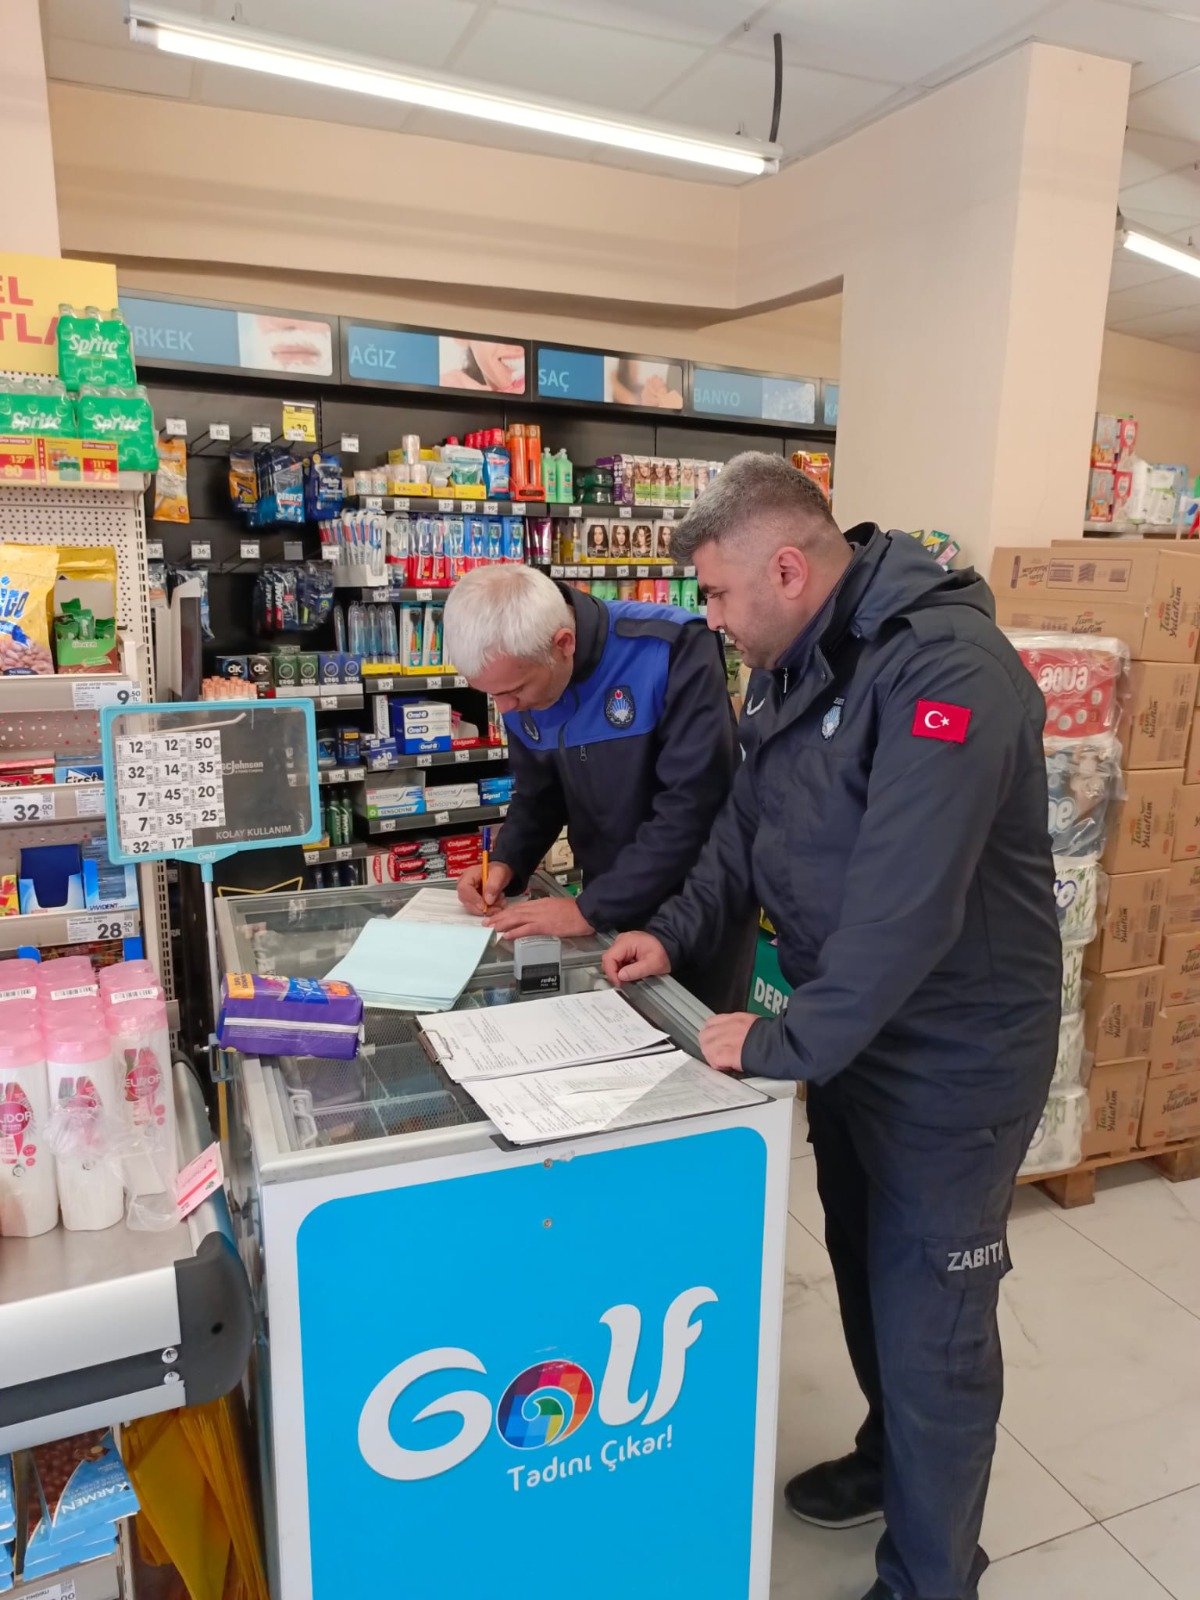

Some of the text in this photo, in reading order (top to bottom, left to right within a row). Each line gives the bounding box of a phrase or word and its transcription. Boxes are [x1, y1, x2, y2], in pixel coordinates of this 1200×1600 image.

[133, 325, 194, 351] RKEK
[69, 334, 119, 355] Sprite
[350, 343, 397, 370] AĞIZ
[538, 368, 570, 392] SAÇ
[694, 387, 741, 408] BANYO
[11, 412, 62, 431] Sprite
[92, 415, 141, 433] Sprite
[117, 690, 130, 704] 9
[129, 741, 144, 753] 12
[165, 739, 179, 751] 12
[195, 737, 212, 749] 50
[128, 766, 145, 778] 32
[165, 764, 180, 776] 14
[198, 762, 213, 773] 35
[165, 789, 181, 800] 45
[198, 786, 215, 798] 20
[482, 792, 501, 800] Signal
[137, 793, 146, 807] 7
[13, 804, 40, 821] 32
[202, 810, 217, 822] 25
[380, 806, 413, 815] SENSODYNE
[139, 817, 148, 831] 7
[167, 813, 183, 825] 35
[216, 825, 292, 840] KOLAY KULLANIM
[133, 841, 150, 853] 32
[172, 838, 185, 849] 17
[394, 844, 418, 852] Colgate
[399, 860, 424, 869] Colgate
[90, 903, 118, 911] VIVIDENT
[97, 923, 122, 939] 28
[357, 1285, 719, 1482] Golf
[61, 1482, 129, 1514] KARMEN
